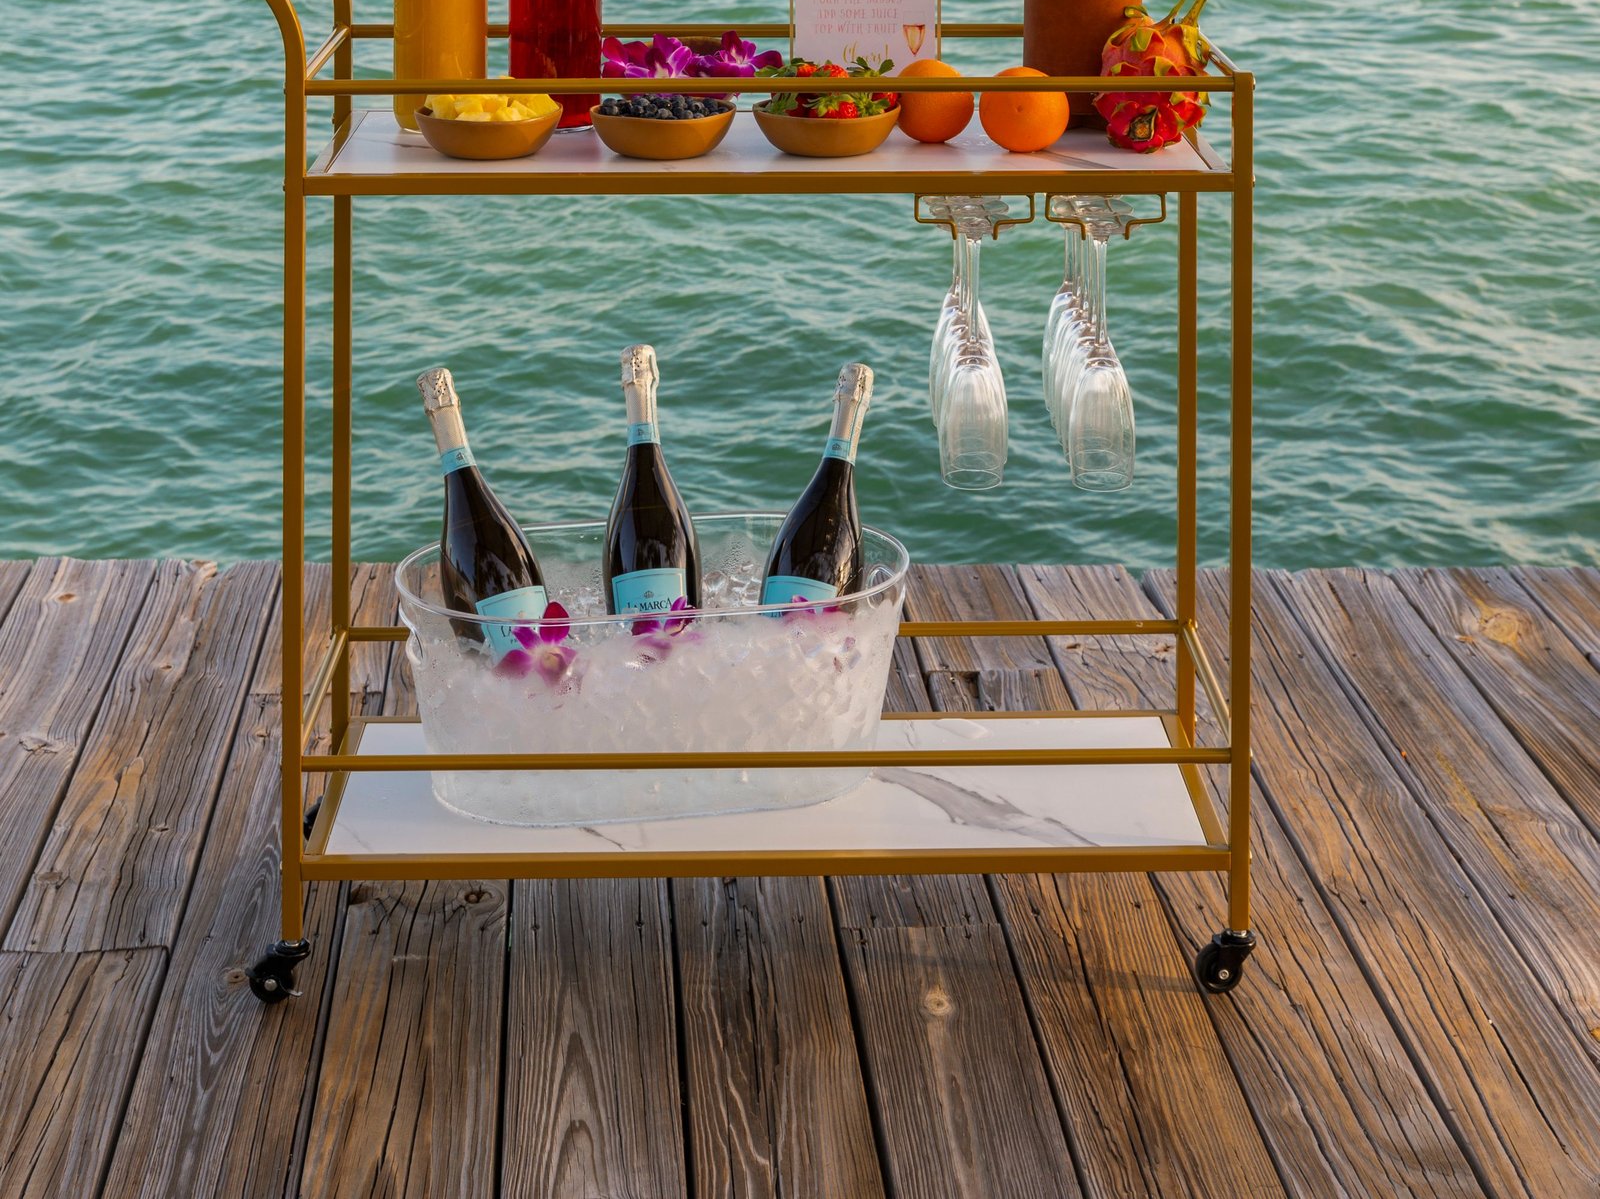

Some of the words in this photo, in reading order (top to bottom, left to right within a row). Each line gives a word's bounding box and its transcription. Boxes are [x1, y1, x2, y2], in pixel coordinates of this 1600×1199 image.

[817, 9, 836, 19] ADD
[840, 8, 865, 19] SOME
[870, 8, 898, 19] JUICE
[814, 23, 833, 34] TOP
[837, 21, 863, 35] WITH
[867, 23, 898, 34] FRUIT
[842, 40, 890, 64] Chers!
[639, 597, 673, 611] MARCA
